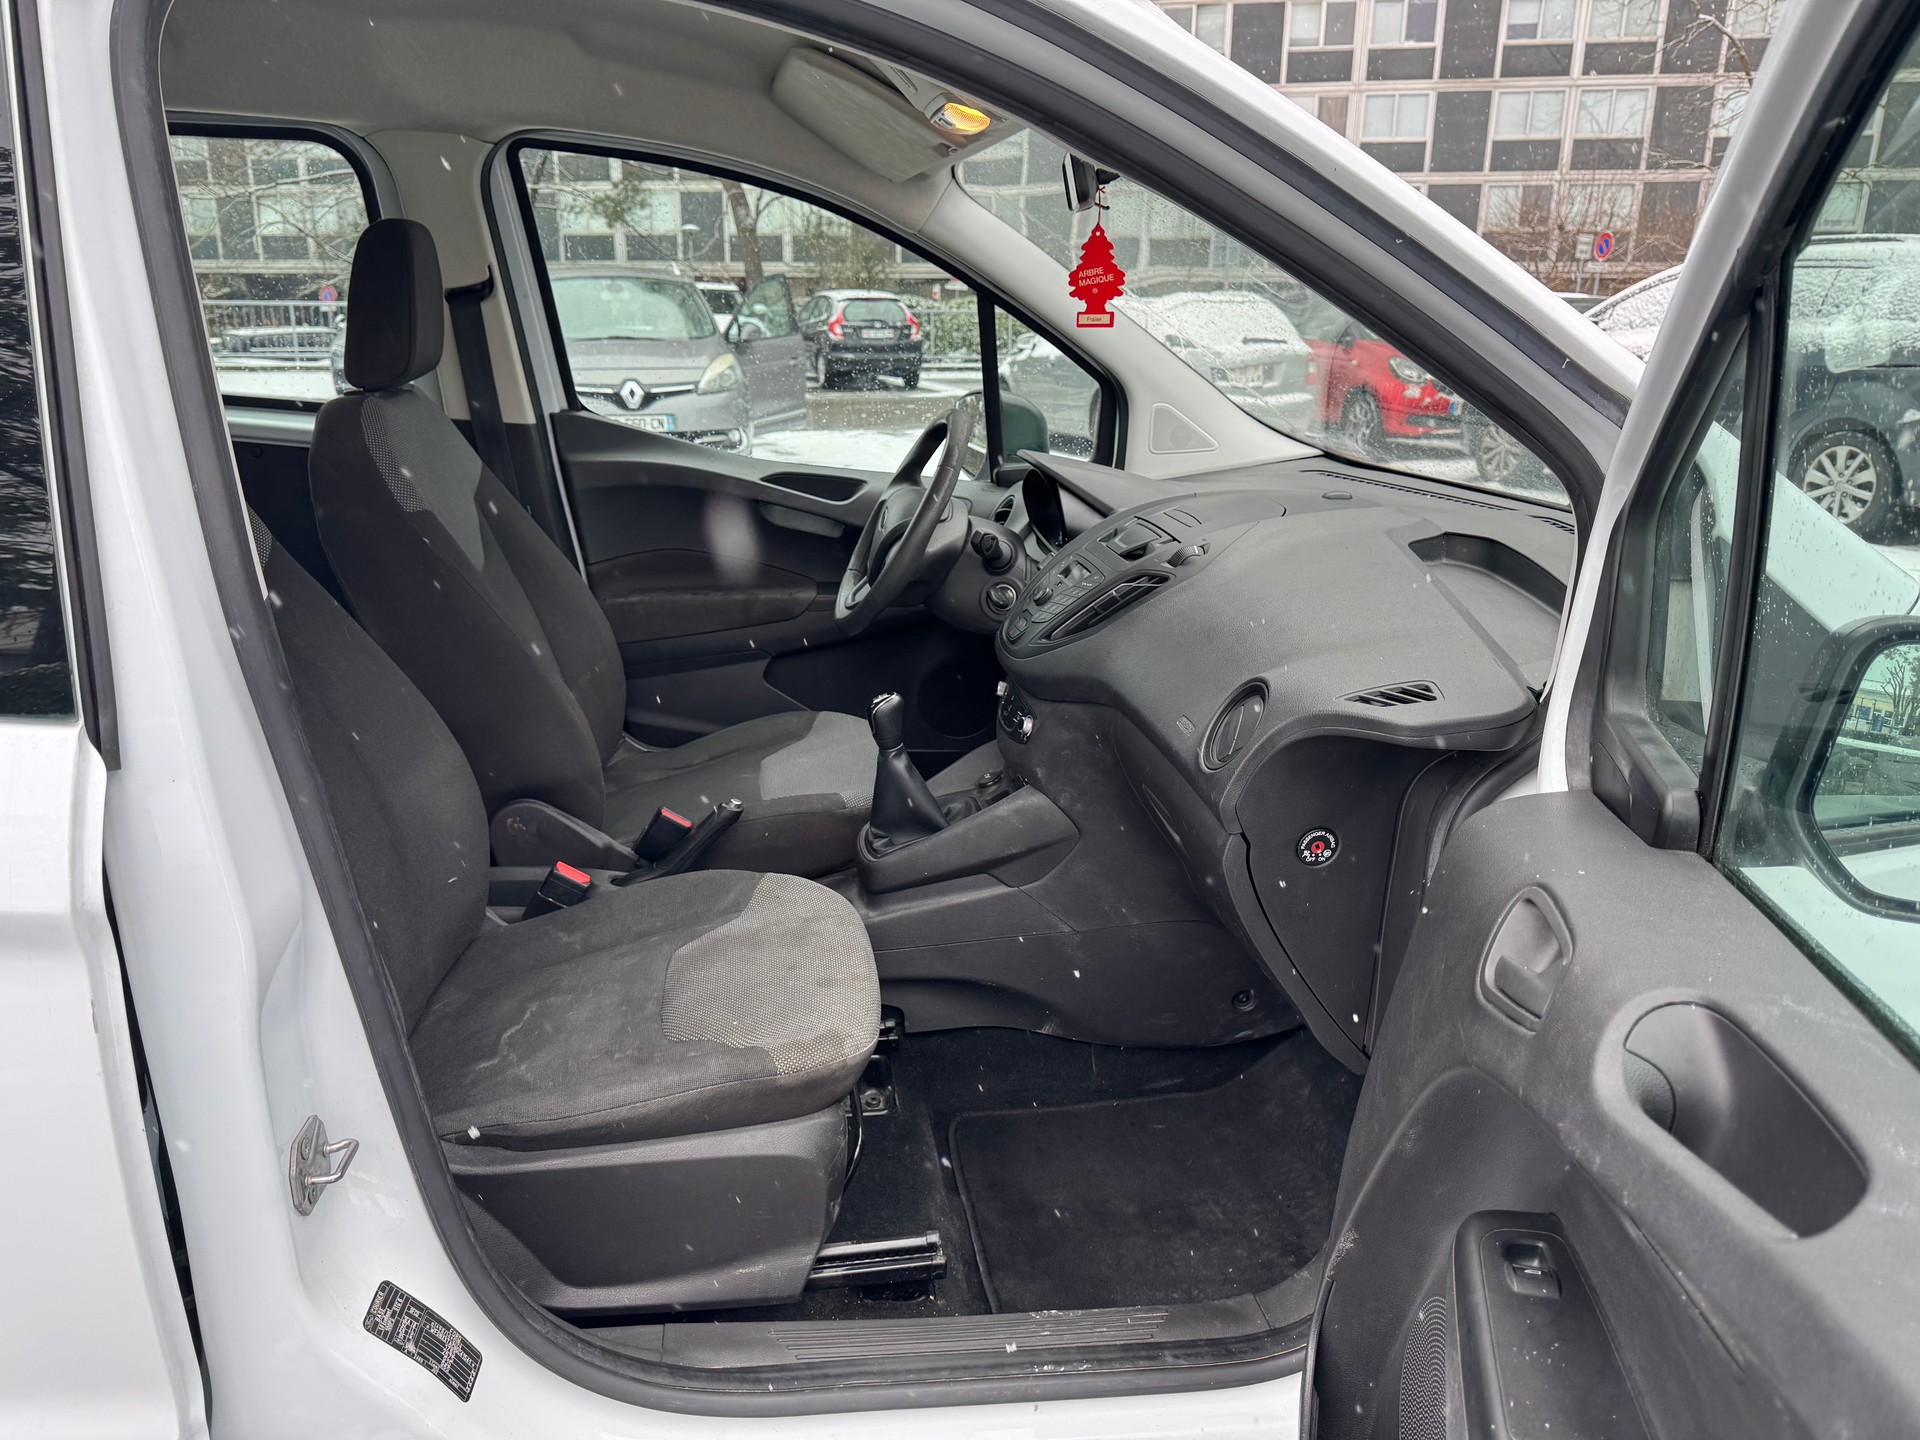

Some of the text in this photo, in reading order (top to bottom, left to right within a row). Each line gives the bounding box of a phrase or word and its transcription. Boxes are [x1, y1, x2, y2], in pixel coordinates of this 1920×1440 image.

[1078, 266, 1104, 279] ARBRE
[1078, 273, 1114, 287] MAGIQUE
[1300, 831, 1336, 850] PASSENGER AIRBAG
